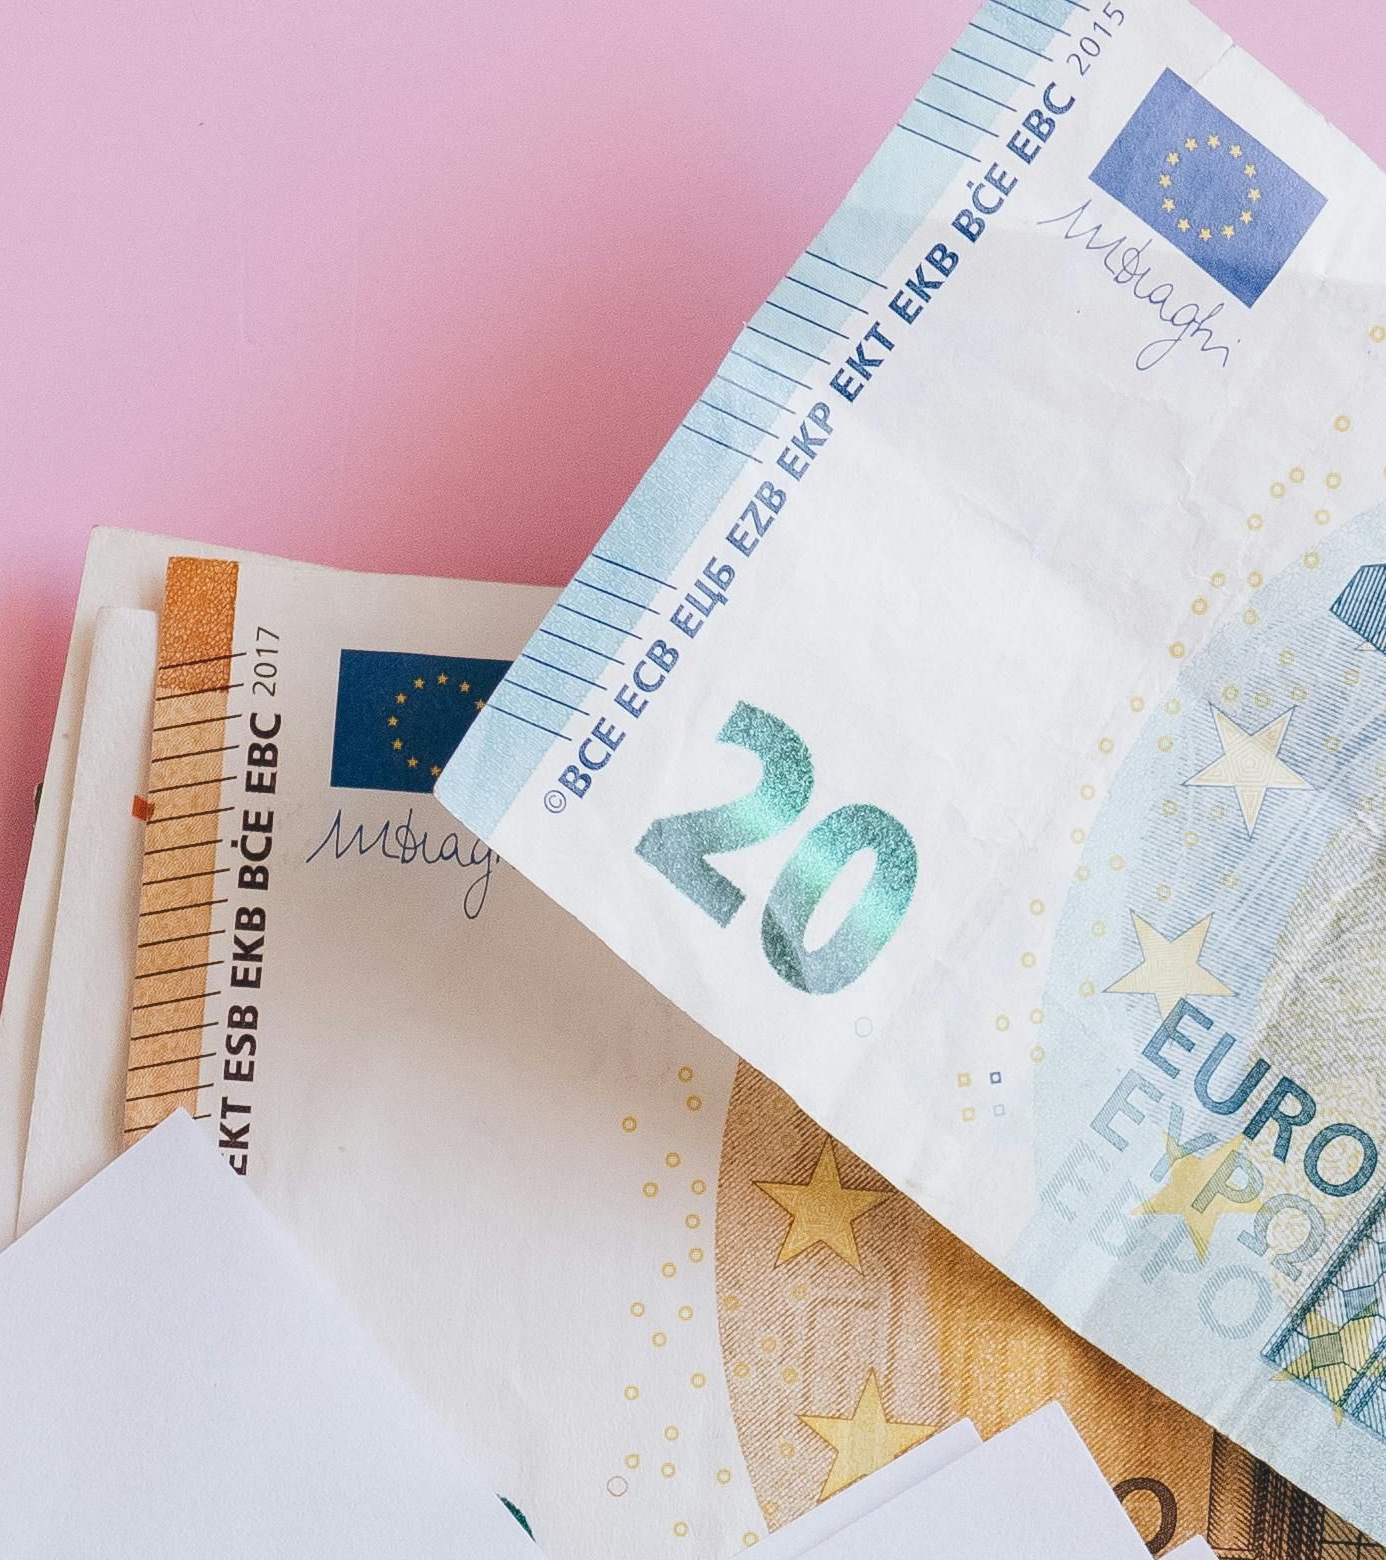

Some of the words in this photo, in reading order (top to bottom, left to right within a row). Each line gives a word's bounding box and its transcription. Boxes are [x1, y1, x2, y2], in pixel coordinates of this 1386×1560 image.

[724, 479, 788, 559] EZB
[774, 400, 835, 483] EKP
[828, 319, 896, 404] EKT
[887, 242, 960, 326] EKB
[1005, 80, 1077, 166] EBC
[1065, 0, 1126, 77] 2015
[250, 625, 281, 698] 2017
[612, 638, 681, 720] ECB
[244, 711, 283, 796] EBC
[634, 700, 919, 996] 20
[229, 905, 267, 990] EKB
[222, 1004, 260, 1083] ESB
[1139, 997, 1379, 1199] EURO
